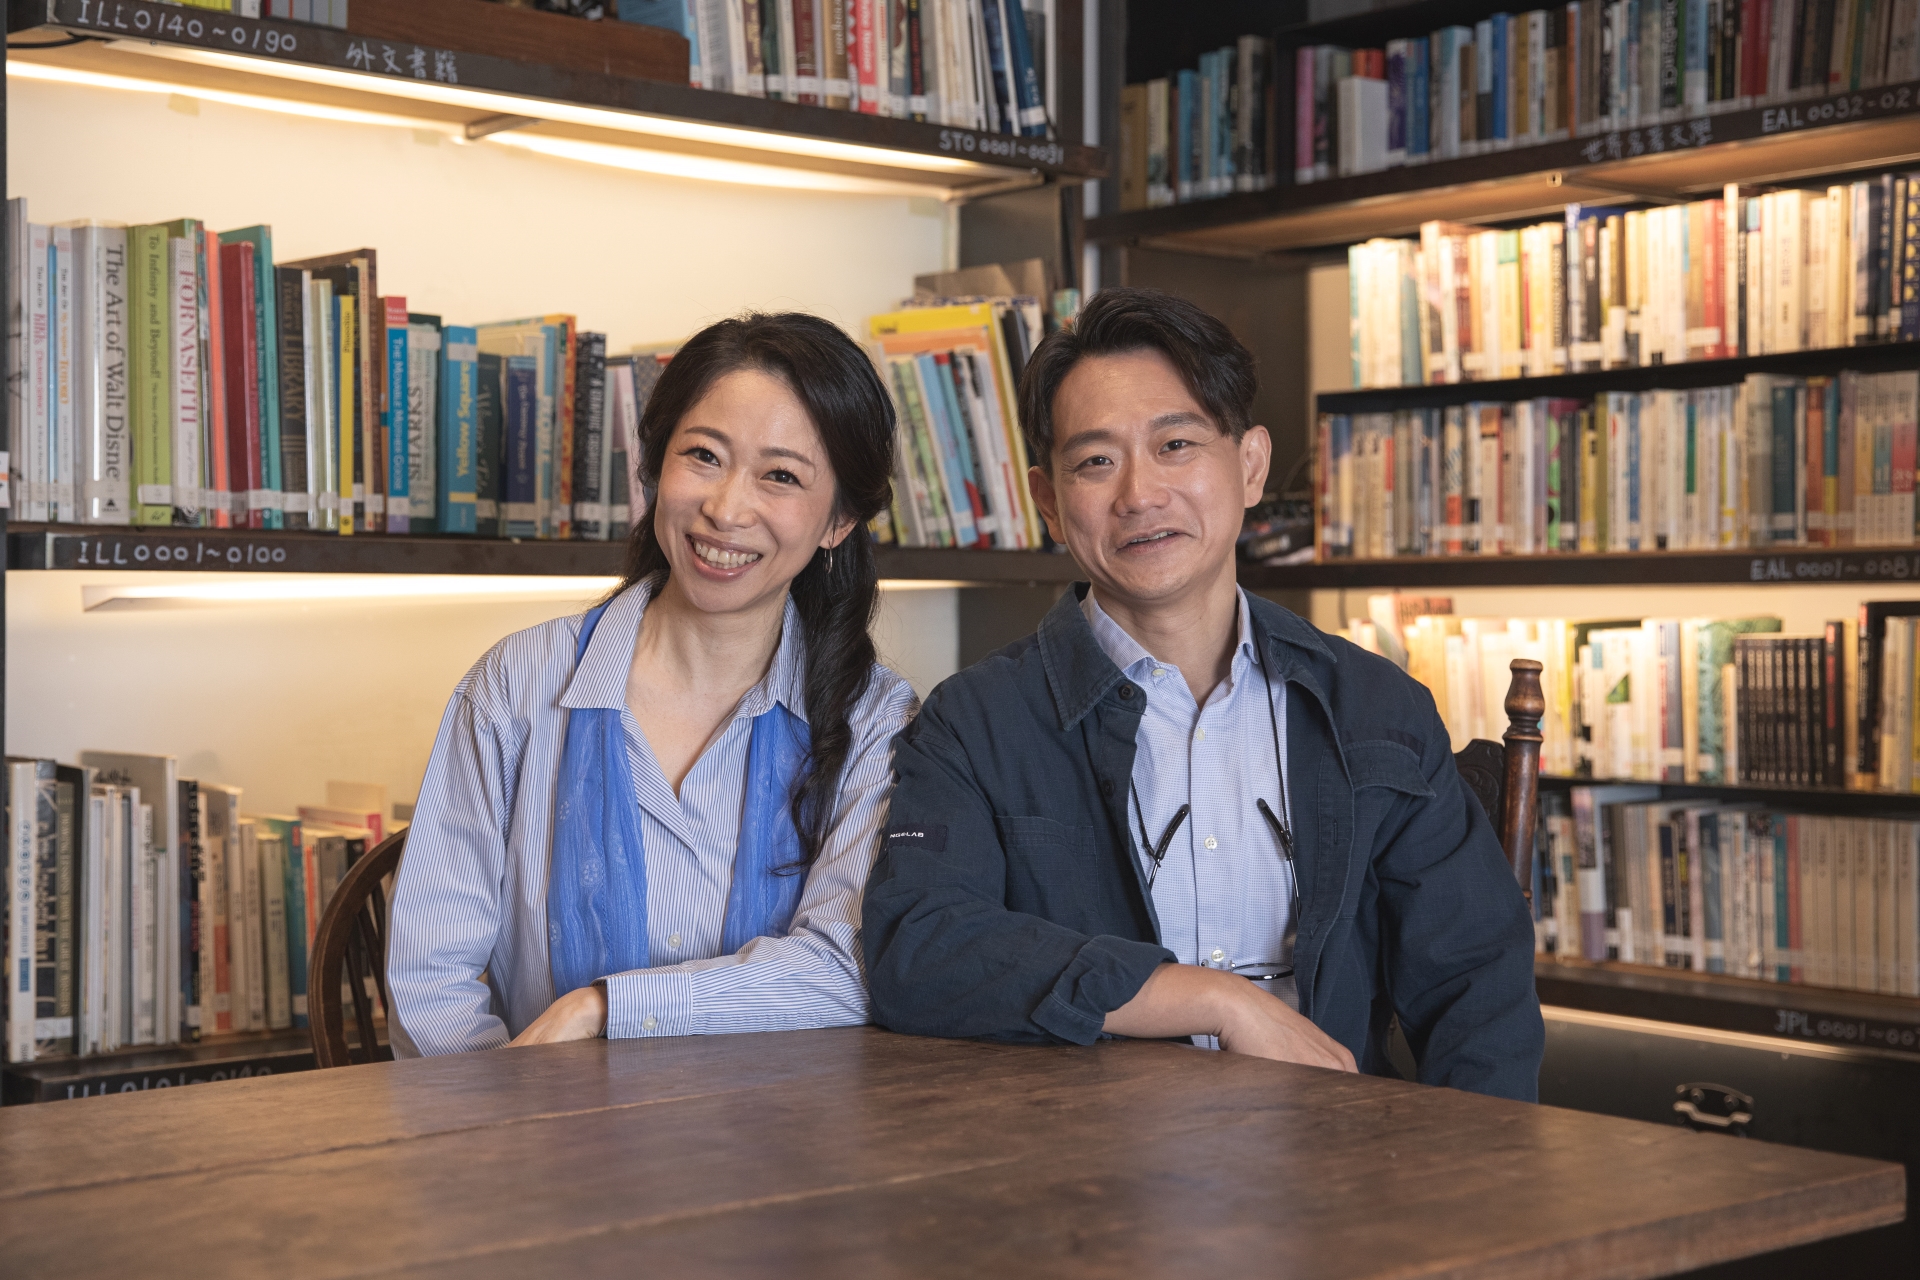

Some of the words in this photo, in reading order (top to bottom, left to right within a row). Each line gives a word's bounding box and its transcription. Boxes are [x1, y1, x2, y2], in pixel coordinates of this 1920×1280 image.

[346, 42, 457, 83] 外文書籍
[1762, 110, 1804, 134] EAL
[1807, 90, 1920, 122] 0032-02
[149, 234, 160, 250] To
[105, 244, 125, 286] The
[147, 255, 161, 298] Infinity
[105, 290, 125, 327] Art
[149, 302, 161, 325] and
[105, 331, 126, 358] of
[179, 270, 199, 424] FORNASETTI
[105, 361, 126, 410] Walt
[282, 335, 305, 423] LIBRARY
[105, 414, 126, 483] Disne
[394, 409, 405, 454] MOTHER
[408, 385, 424, 481] SHARKS
[456, 421, 471, 477] Yellow
[1750, 557, 1793, 580] EAL
